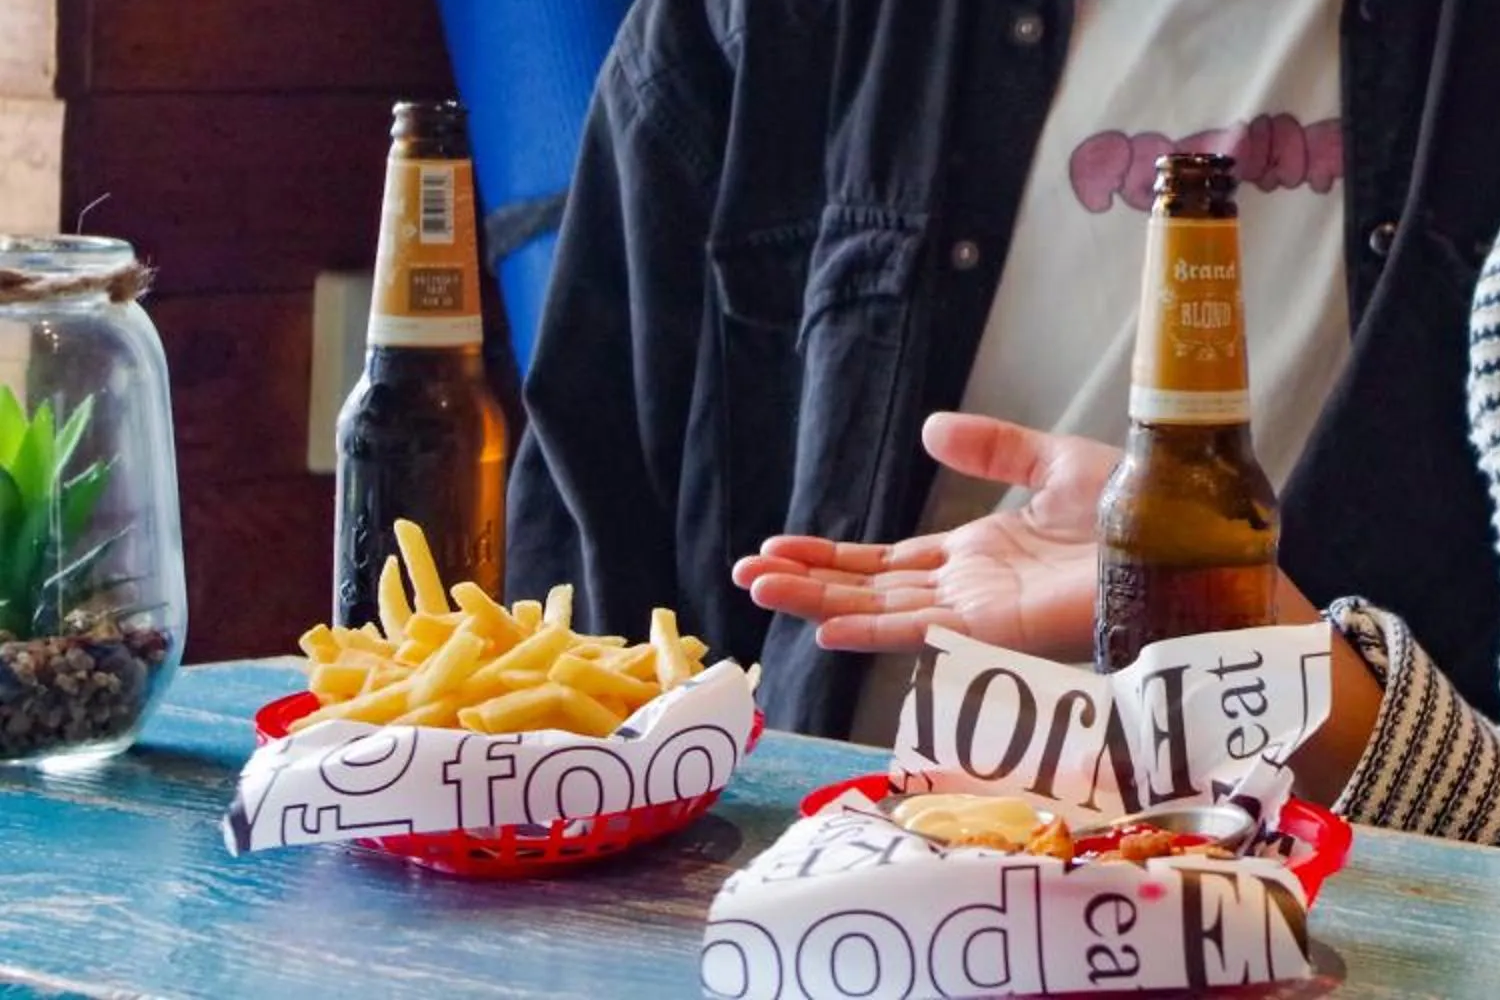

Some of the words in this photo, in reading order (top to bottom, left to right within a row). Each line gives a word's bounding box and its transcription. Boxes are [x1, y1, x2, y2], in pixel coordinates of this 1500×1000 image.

[1173, 258, 1236, 281] Brand
[1181, 300, 1231, 329] BLOND
[1207, 648, 1271, 762] eat
